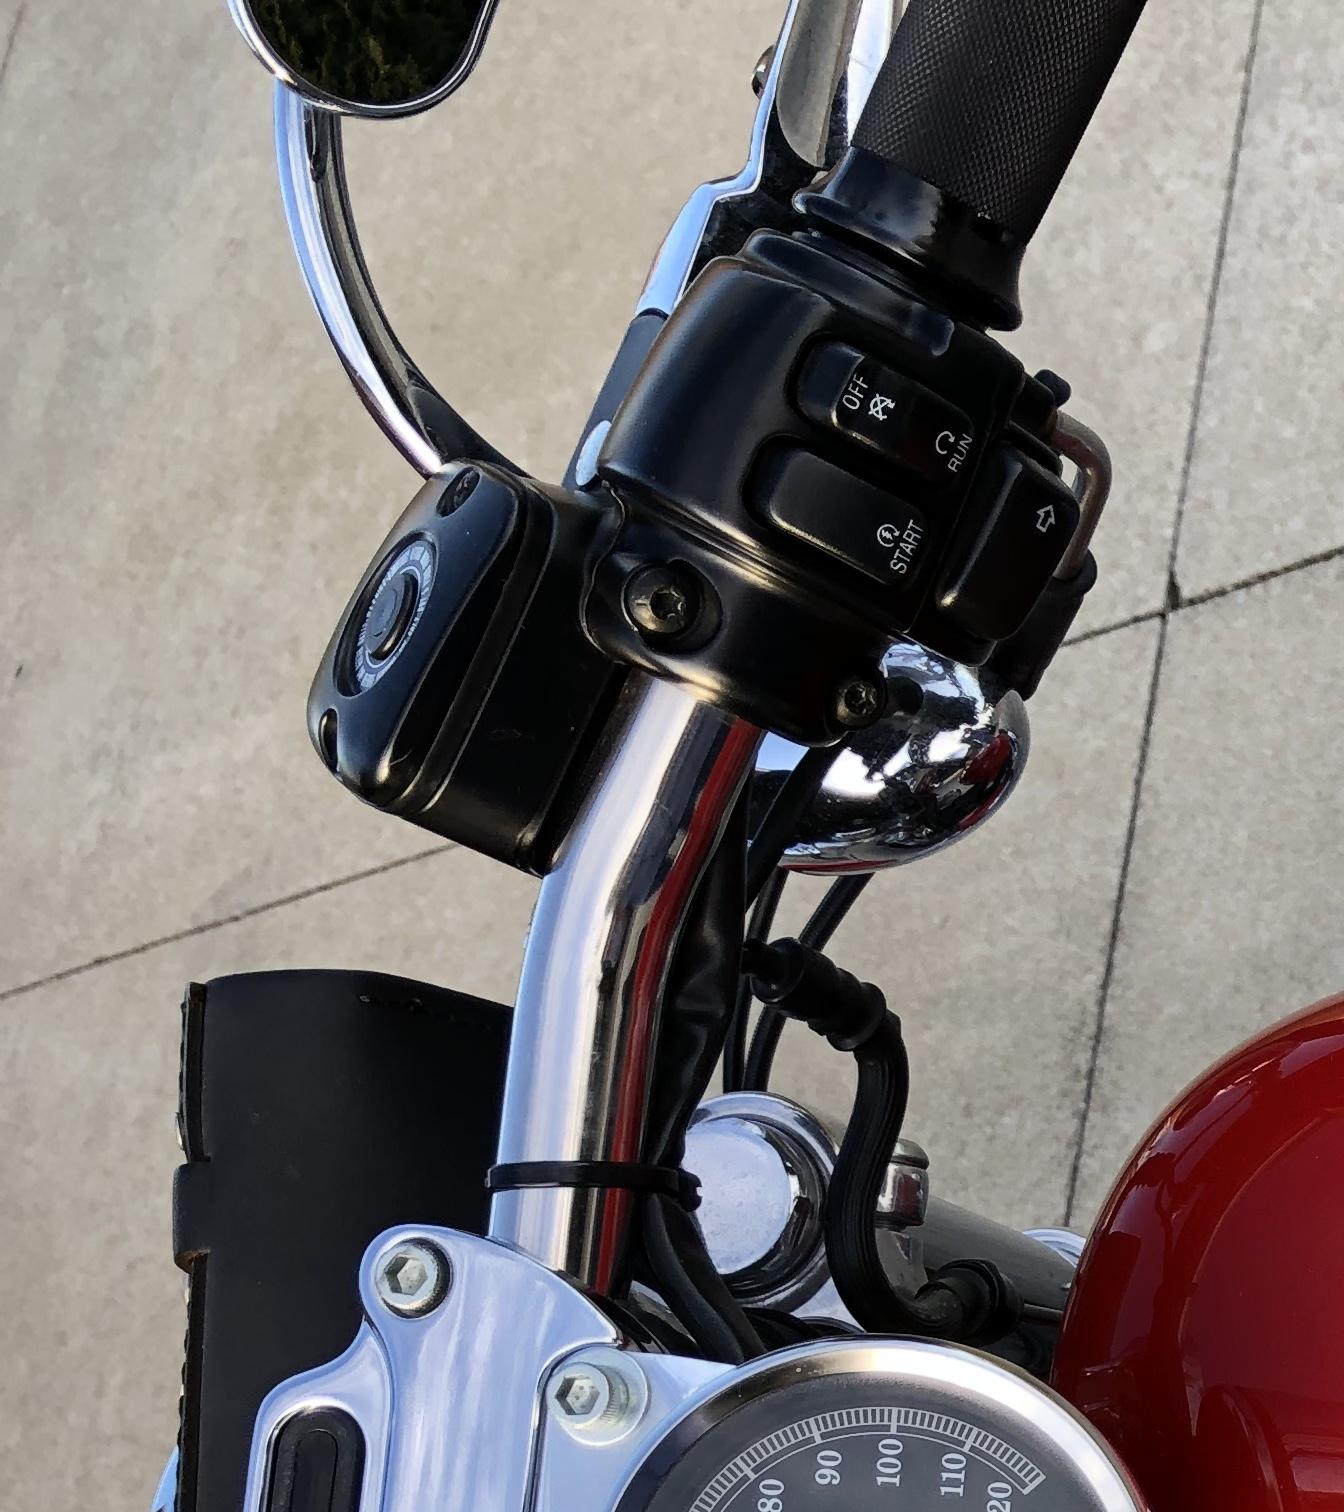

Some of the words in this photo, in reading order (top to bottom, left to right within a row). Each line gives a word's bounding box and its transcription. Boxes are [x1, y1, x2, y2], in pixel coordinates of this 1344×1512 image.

[842, 374, 869, 411] OFF
[947, 432, 973, 473] RUN
[889, 519, 924, 574] START
[814, 1448, 844, 1486] 90
[875, 1437, 906, 1487] 100
[940, 1451, 967, 1497] 110
